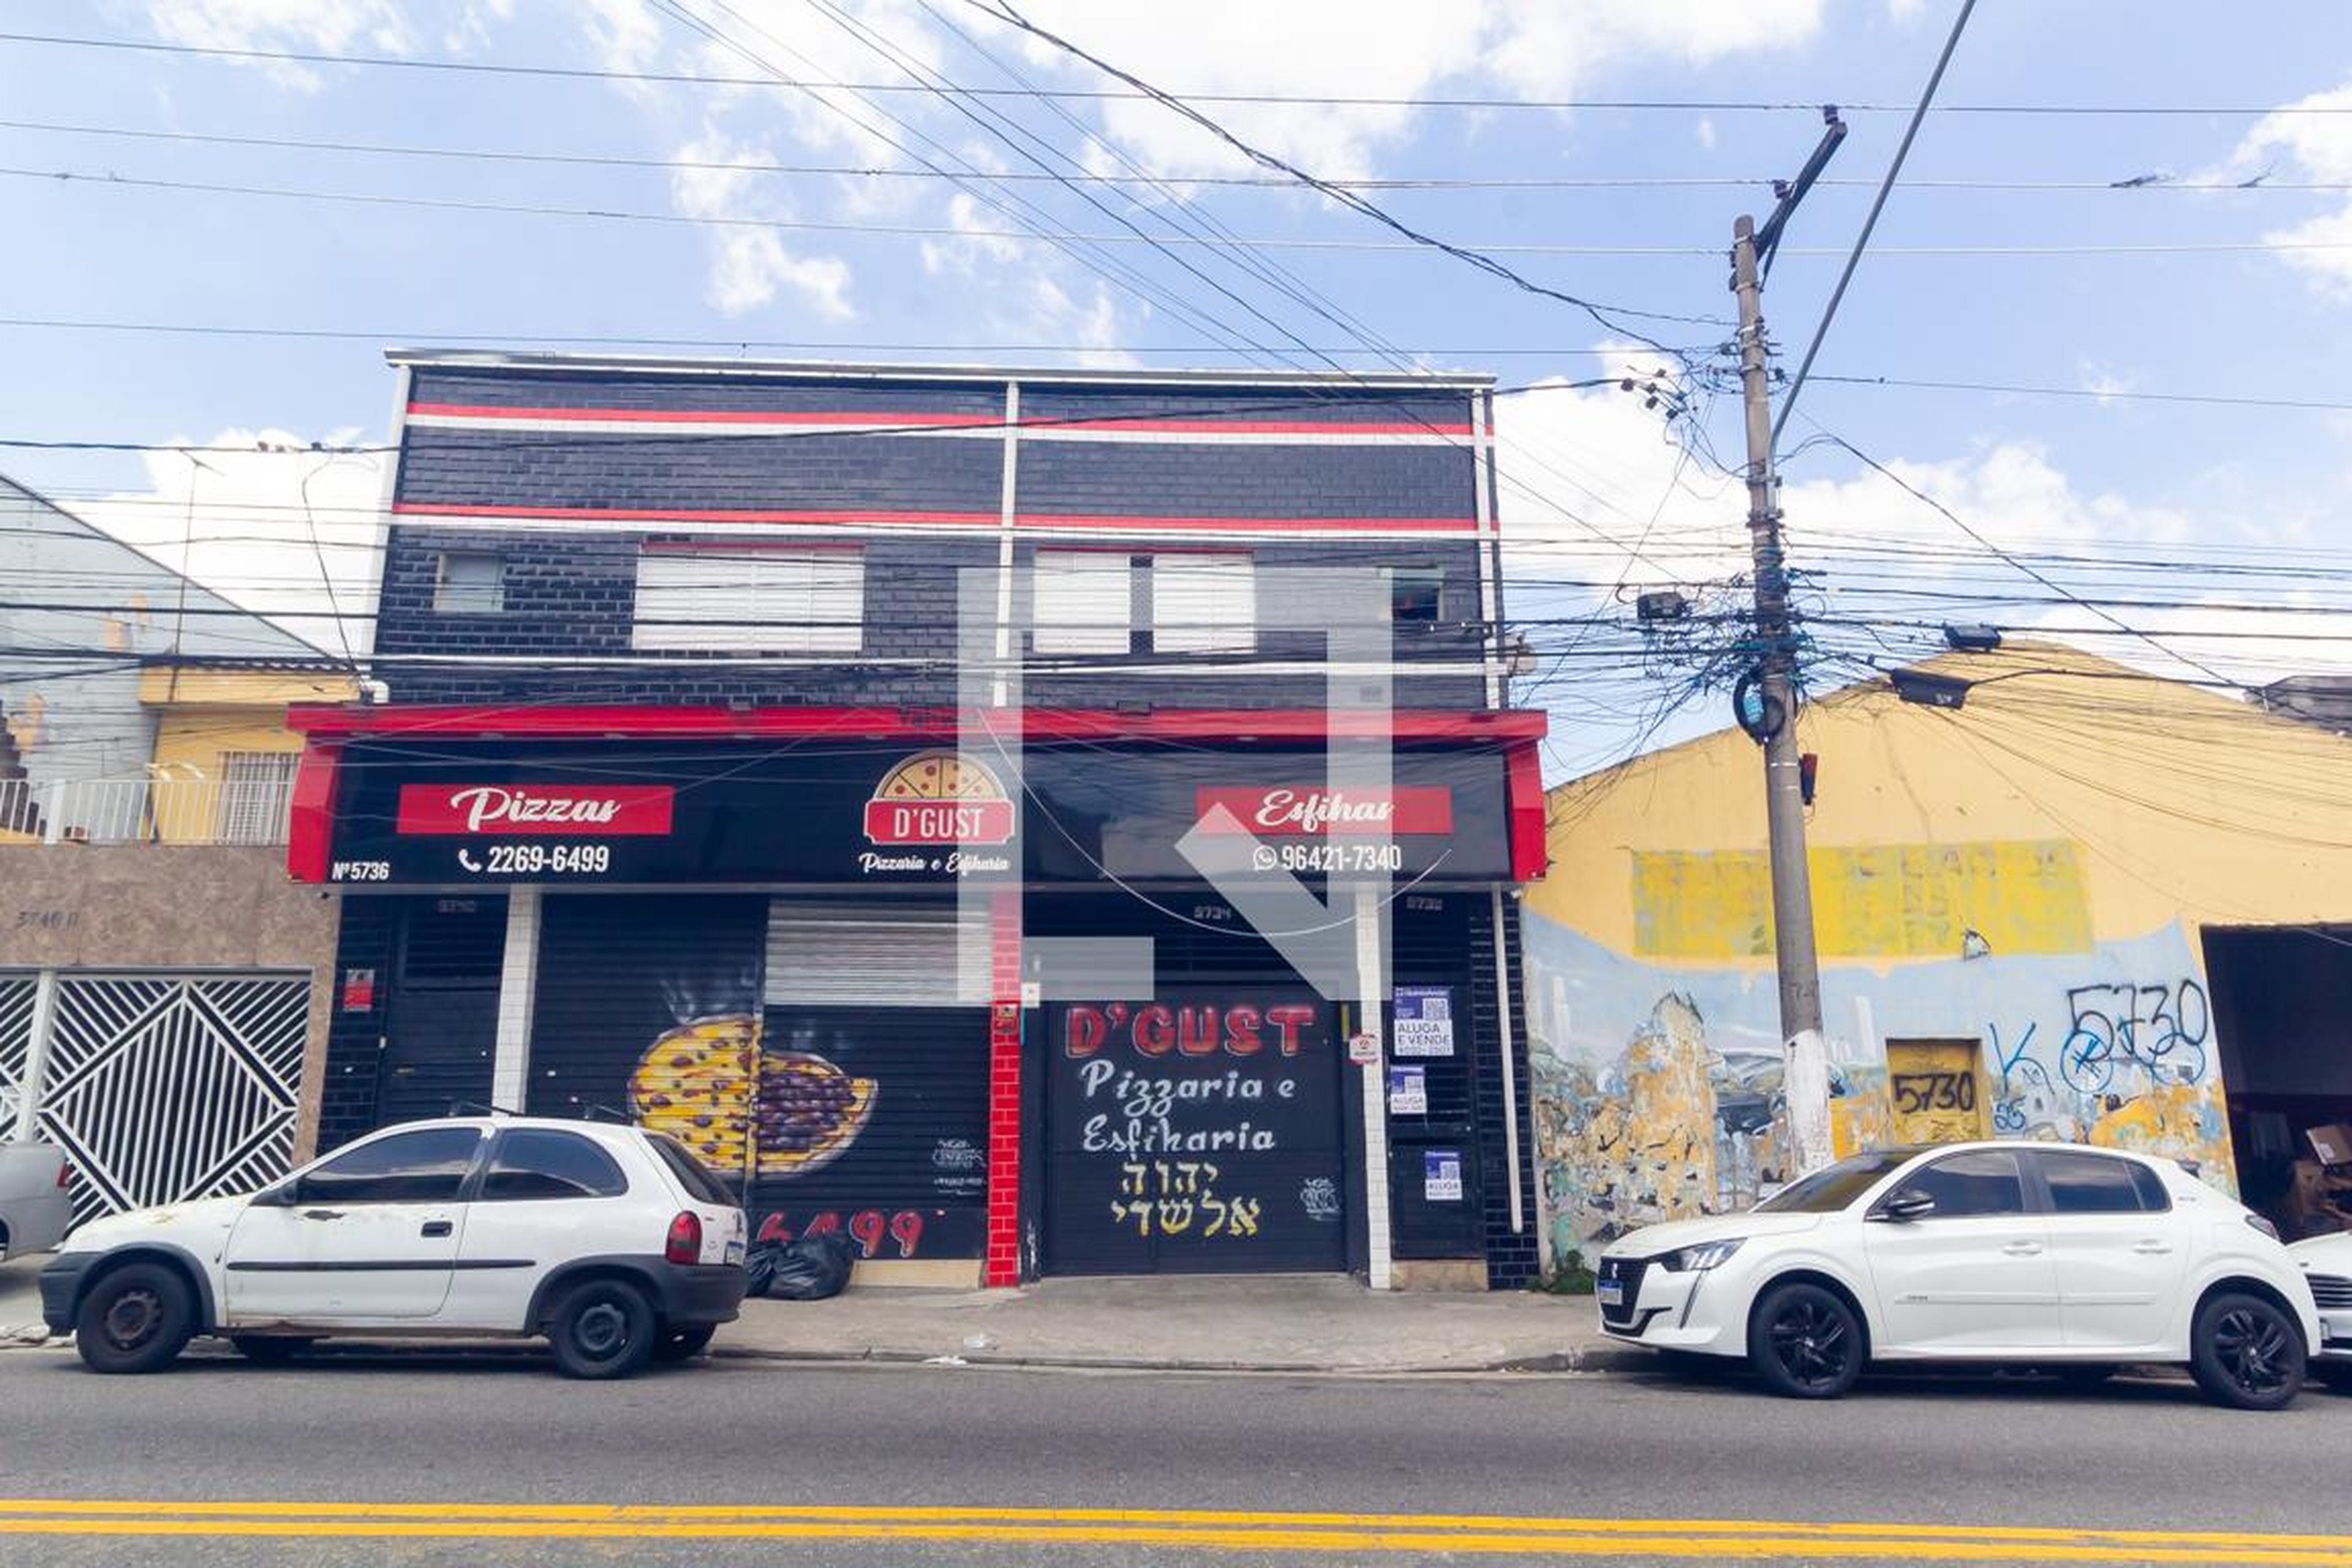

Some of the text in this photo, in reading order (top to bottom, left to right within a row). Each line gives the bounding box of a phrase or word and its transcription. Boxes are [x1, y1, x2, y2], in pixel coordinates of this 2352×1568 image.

[450, 787, 620, 832] Pizzas
[894, 808, 984, 838] D'GUST
[1255, 790, 1393, 832] Esfihas
[488, 846, 609, 873] 2269-6499
[859, 853, 926, 873] Pizzaria
[931, 858, 941, 870] e
[1282, 845, 1401, 870] 96421-7340
[1066, 1005, 1315, 1058] D'GUST
[1398, 1022, 1440, 1033] ALUGA
[1408, 1034, 1450, 1044] VENDE
[1080, 1059, 1297, 1117] Pizzaria e
[1891, 1071, 1977, 1114] 5730
[1083, 1114, 1276, 1162] Esfiharia
[1122, 1160, 1218, 1195] יהוה
